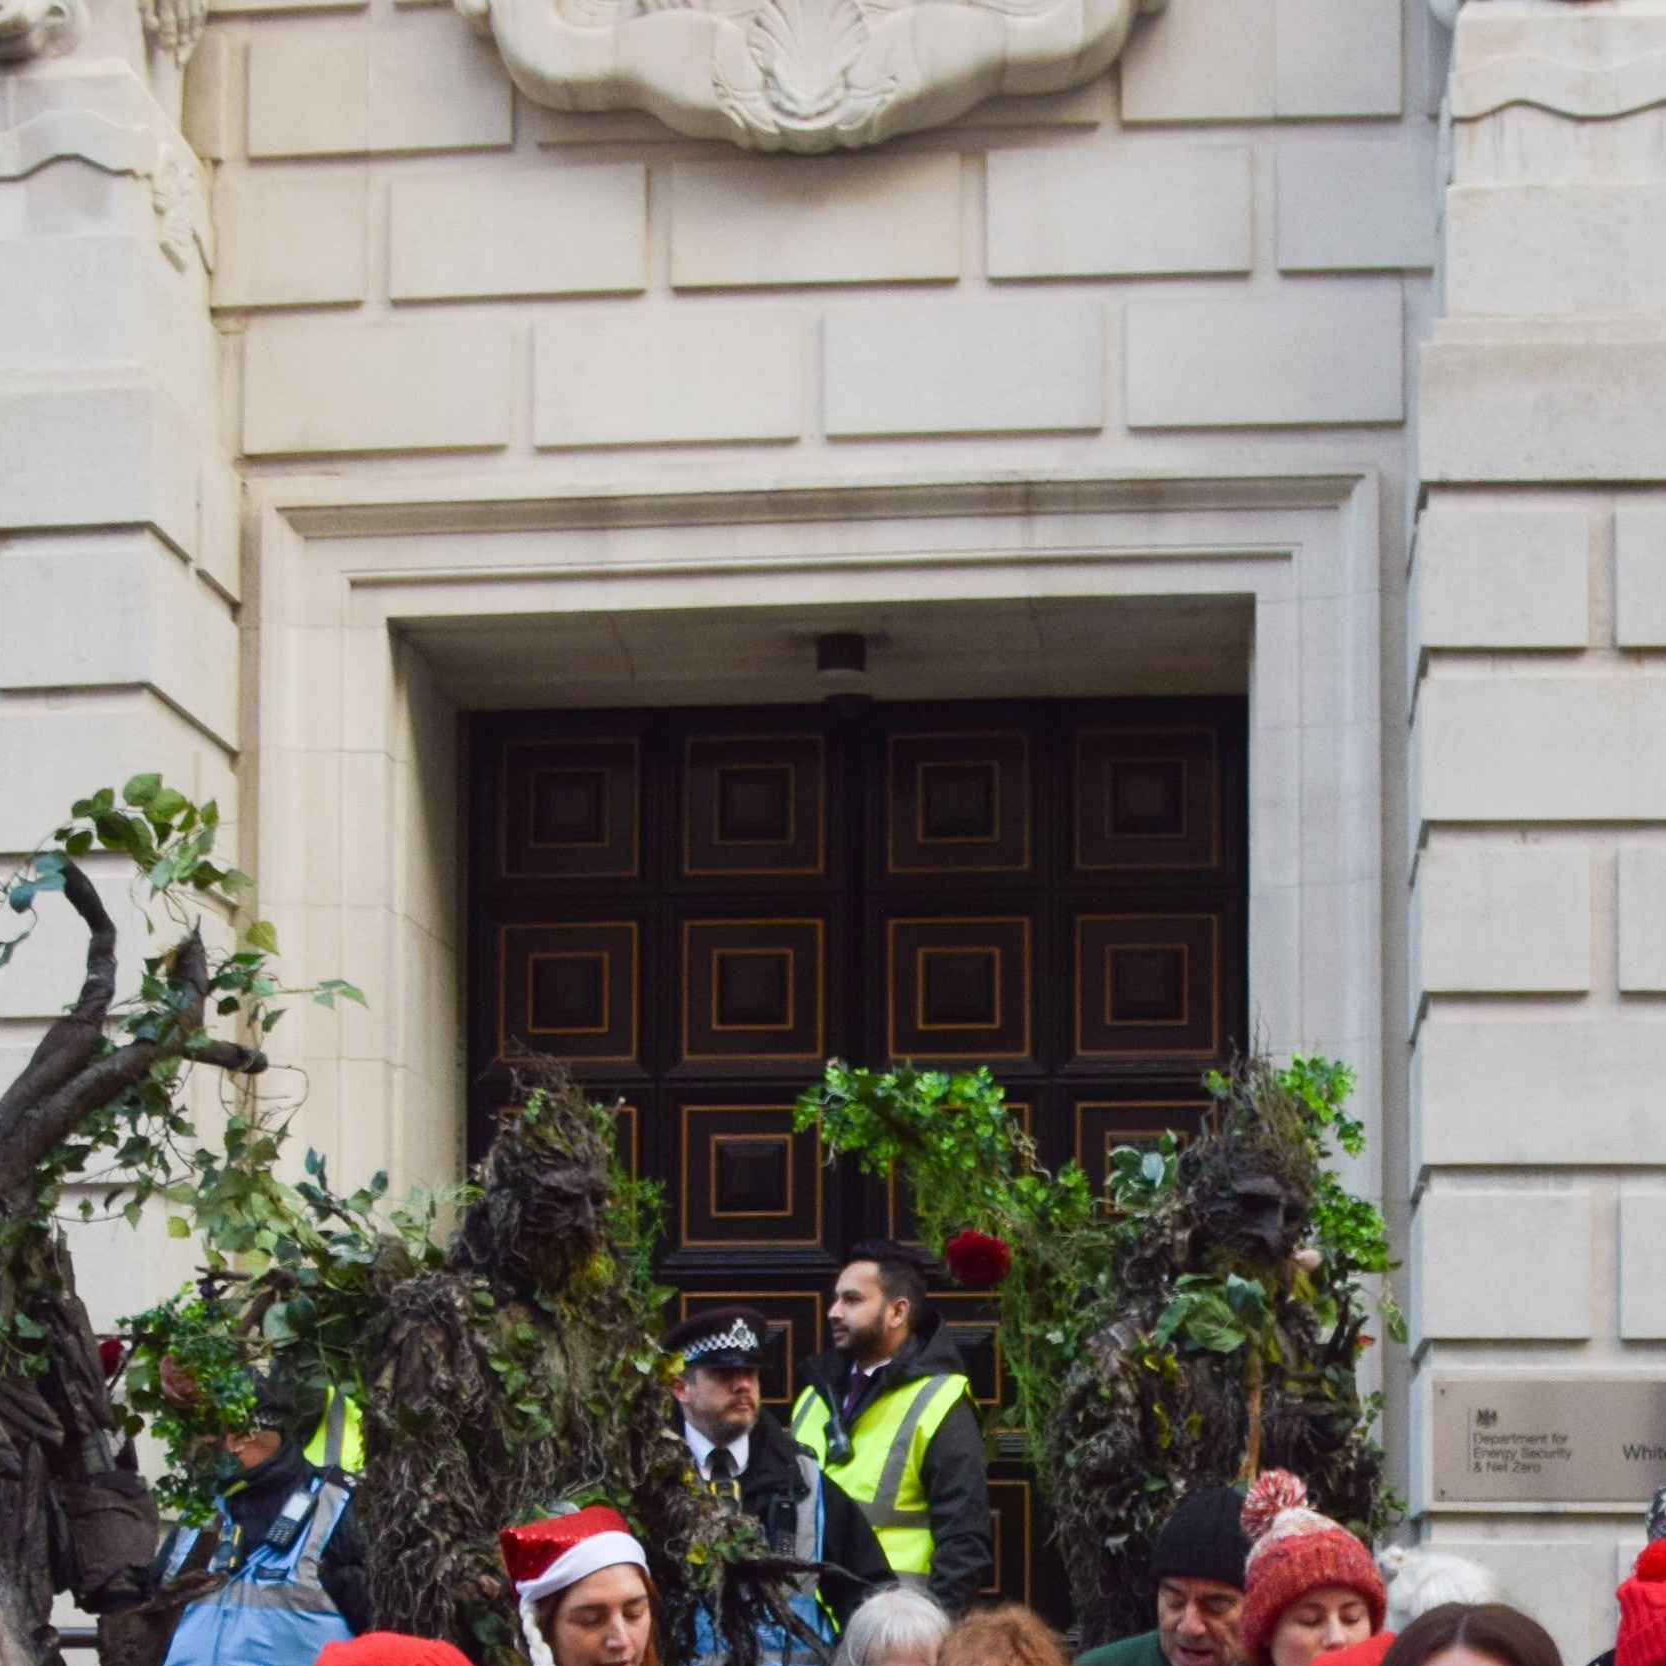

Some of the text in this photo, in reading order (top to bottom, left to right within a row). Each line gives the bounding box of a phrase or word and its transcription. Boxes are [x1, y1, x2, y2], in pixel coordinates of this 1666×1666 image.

[1473, 1433, 1569, 1446] Department for
[1473, 1447, 1572, 1461] Energy Security
[1474, 1461, 1542, 1473] & Net Zero
